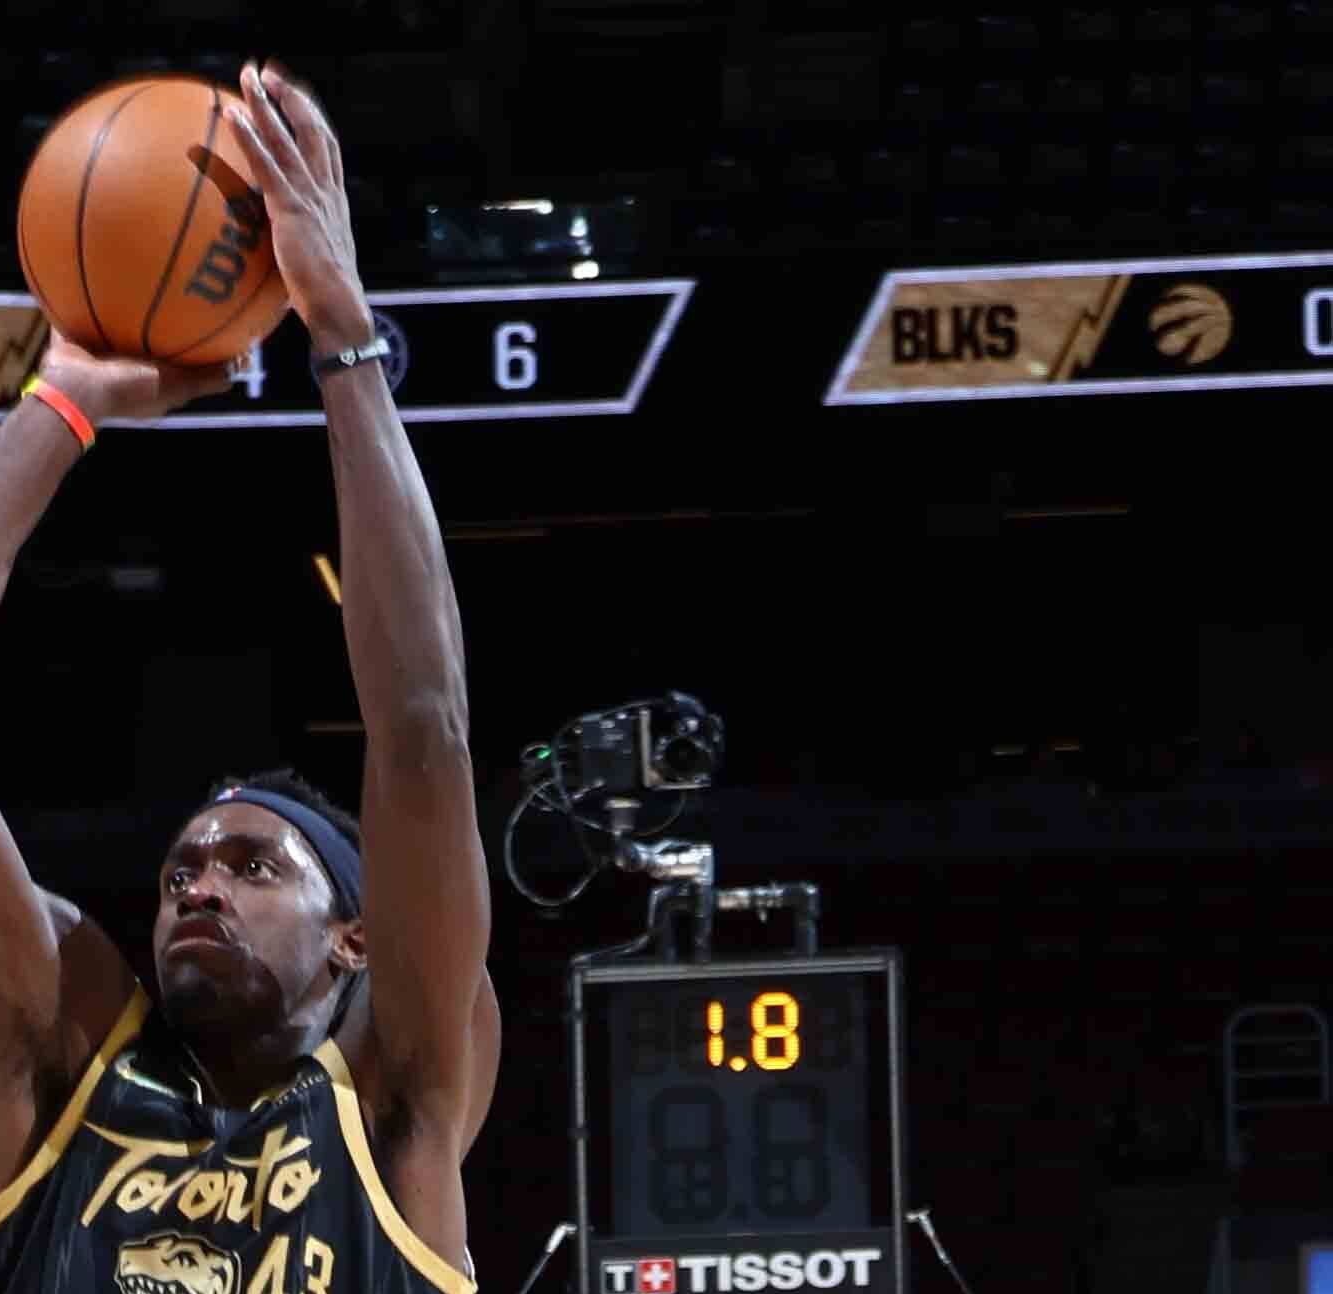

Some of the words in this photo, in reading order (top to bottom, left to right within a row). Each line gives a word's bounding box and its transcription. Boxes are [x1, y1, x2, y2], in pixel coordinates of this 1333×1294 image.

[493, 323, 538, 391] 6
[891, 304, 1019, 366] BLKS
[705, 990, 801, 1073] 1.8
[81, 1122, 322, 1233] Toronto
[677, 1248, 883, 1294] TISSOT
